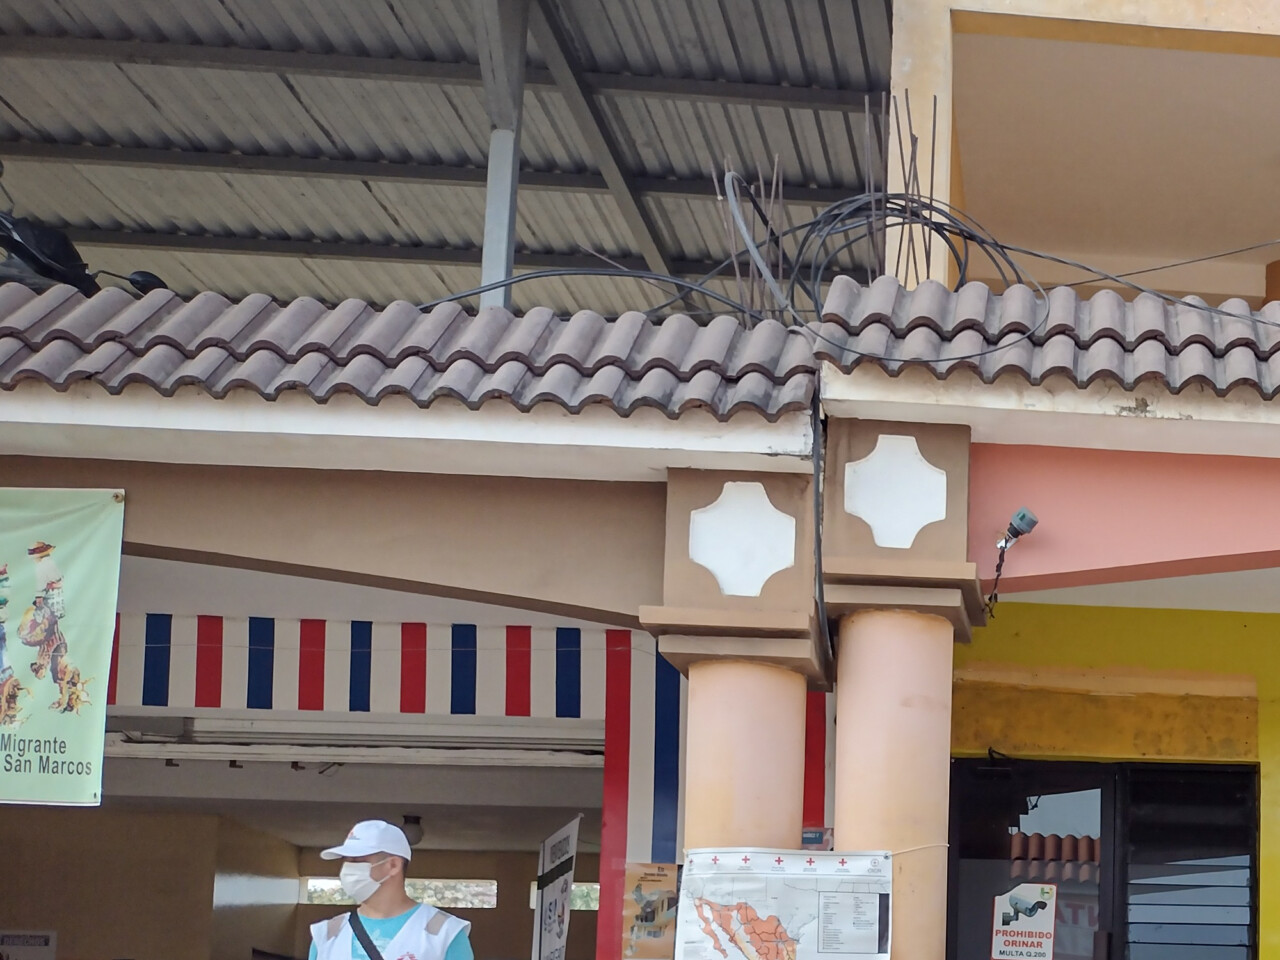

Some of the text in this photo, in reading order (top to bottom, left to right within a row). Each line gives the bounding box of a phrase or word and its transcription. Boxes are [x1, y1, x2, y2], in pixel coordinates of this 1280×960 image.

[0, 733, 67, 757] Migrante
[4, 754, 92, 776] San Marcos
[995, 929, 1052, 940] PROHIBIDO
[1004, 940, 1042, 948] ORINAR
